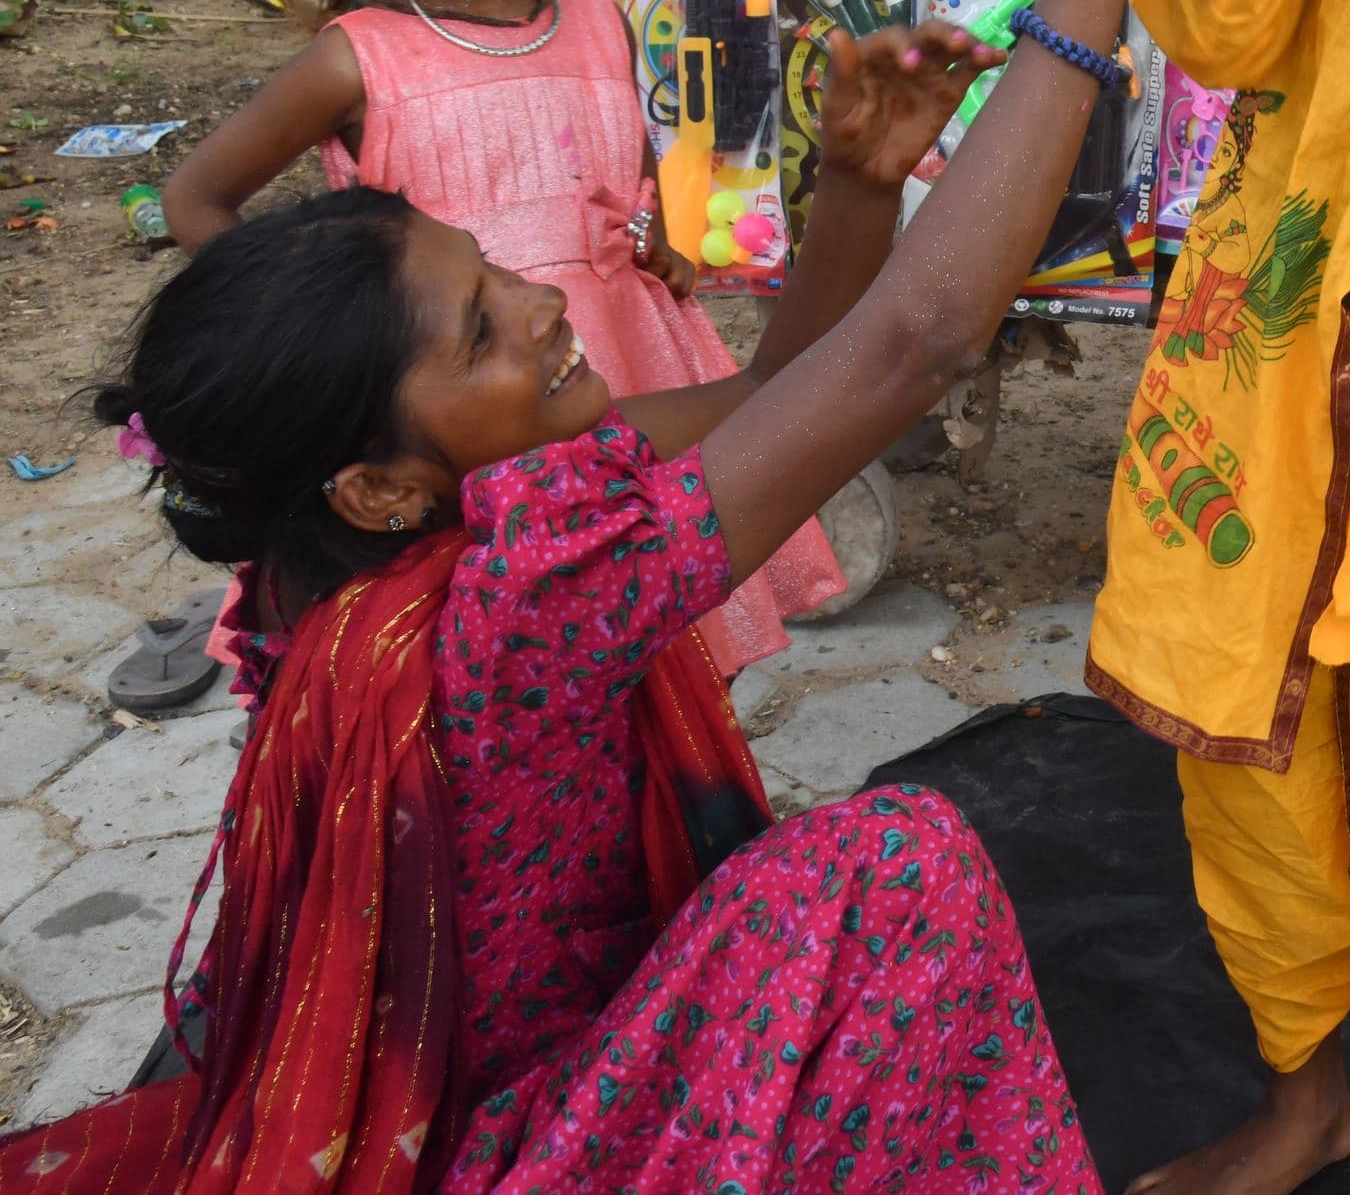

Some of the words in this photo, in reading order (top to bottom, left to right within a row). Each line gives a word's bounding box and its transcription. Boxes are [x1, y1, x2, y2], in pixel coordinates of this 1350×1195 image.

[1141, 132, 1155, 176] Safe
[1137, 181, 1151, 224] Soft
[1068, 304, 1090, 315] Model
[1092, 307, 1105, 316] No.
[1108, 307, 1135, 318] 7575
[1146, 368, 1172, 405] श्री
[1174, 396, 1216, 452] राधे
